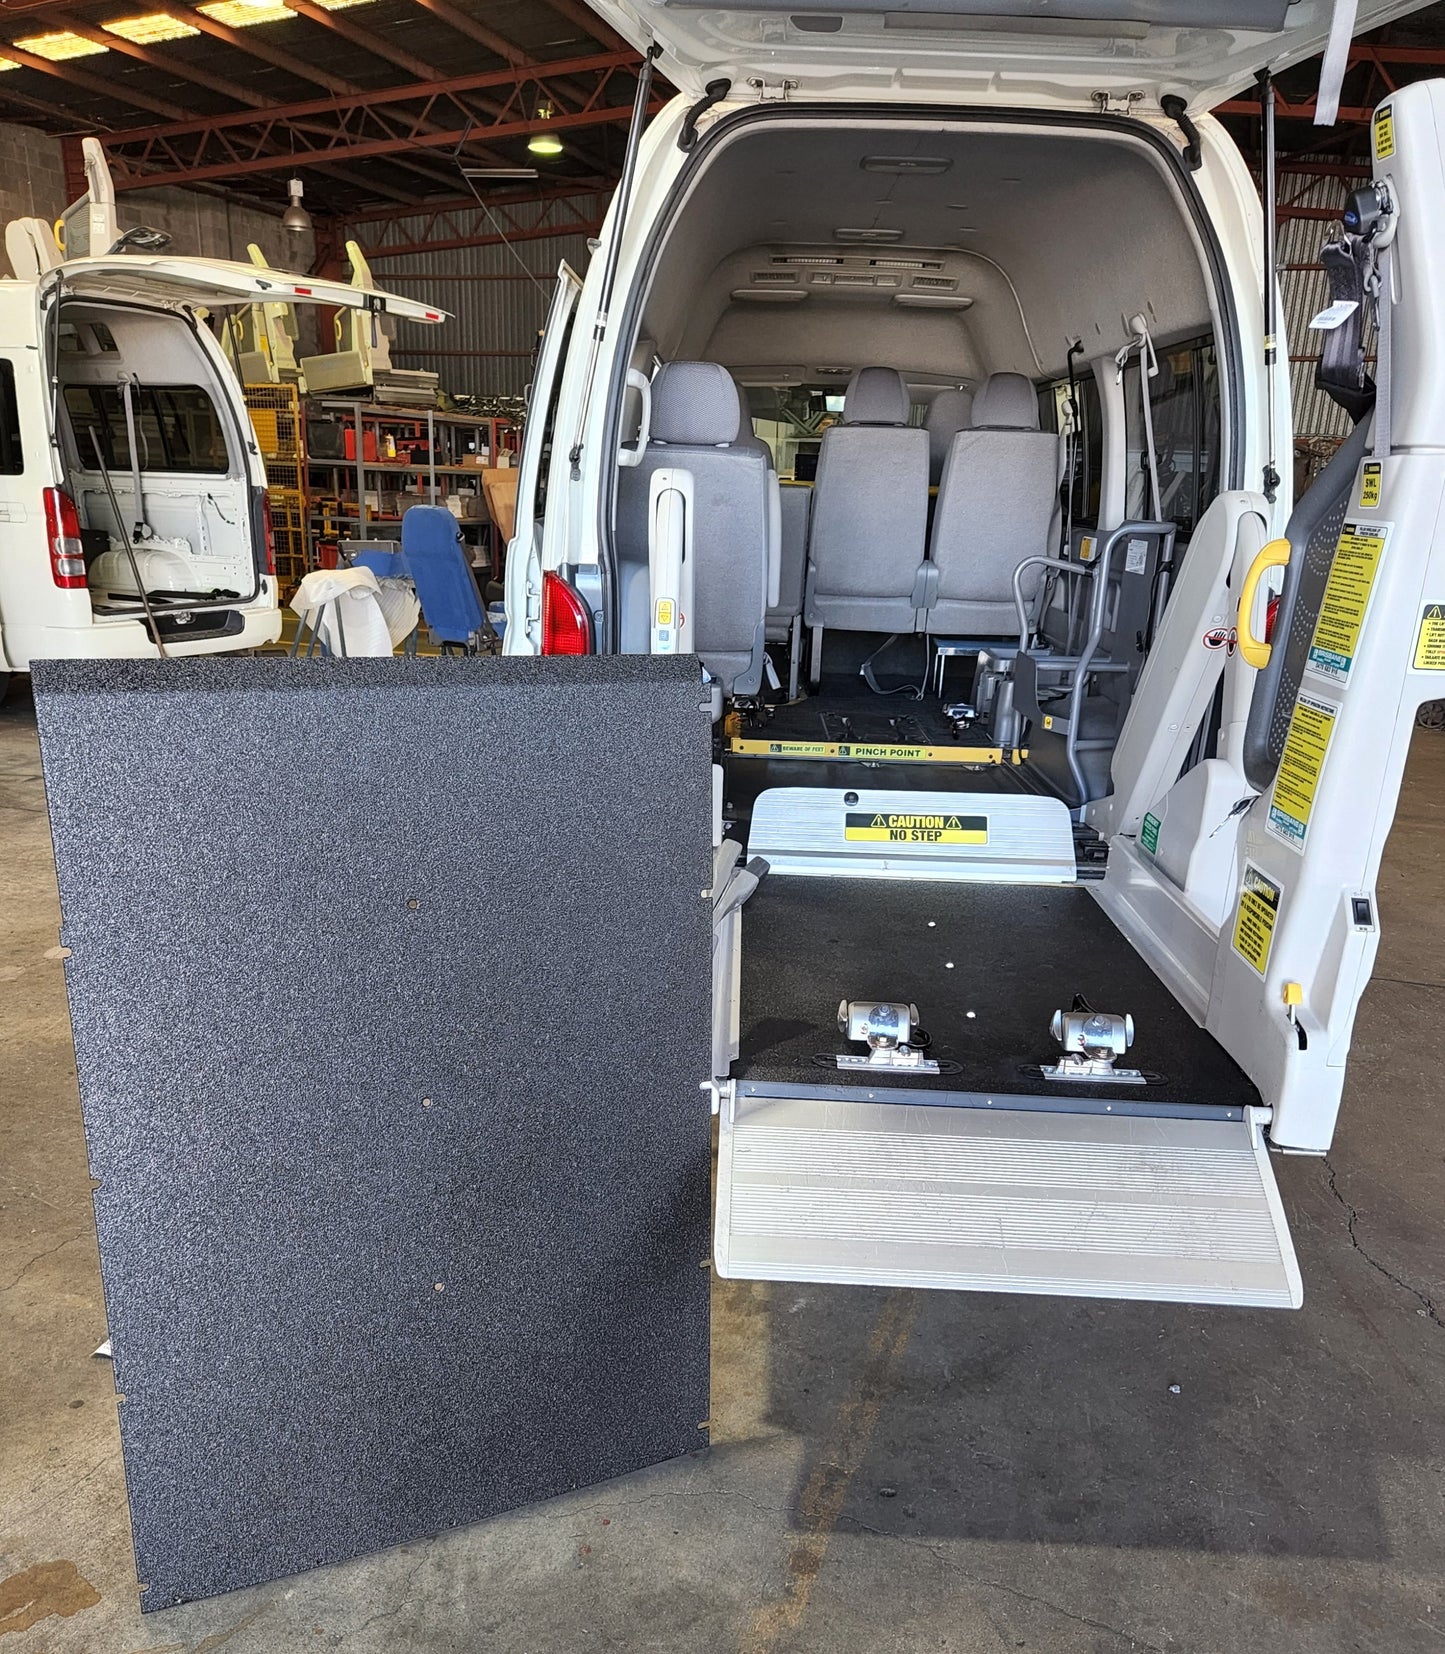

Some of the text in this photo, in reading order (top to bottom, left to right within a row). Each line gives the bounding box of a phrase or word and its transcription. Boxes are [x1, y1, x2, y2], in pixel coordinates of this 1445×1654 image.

[1365, 478, 1376, 487] SWL
[1363, 491, 1377, 501] 250kg
[856, 748, 921, 757] PINCH POINT
[888, 815, 944, 828] CAUTION
[890, 830, 942, 841] NO STEP
[1254, 875, 1276, 902] CAUTION
